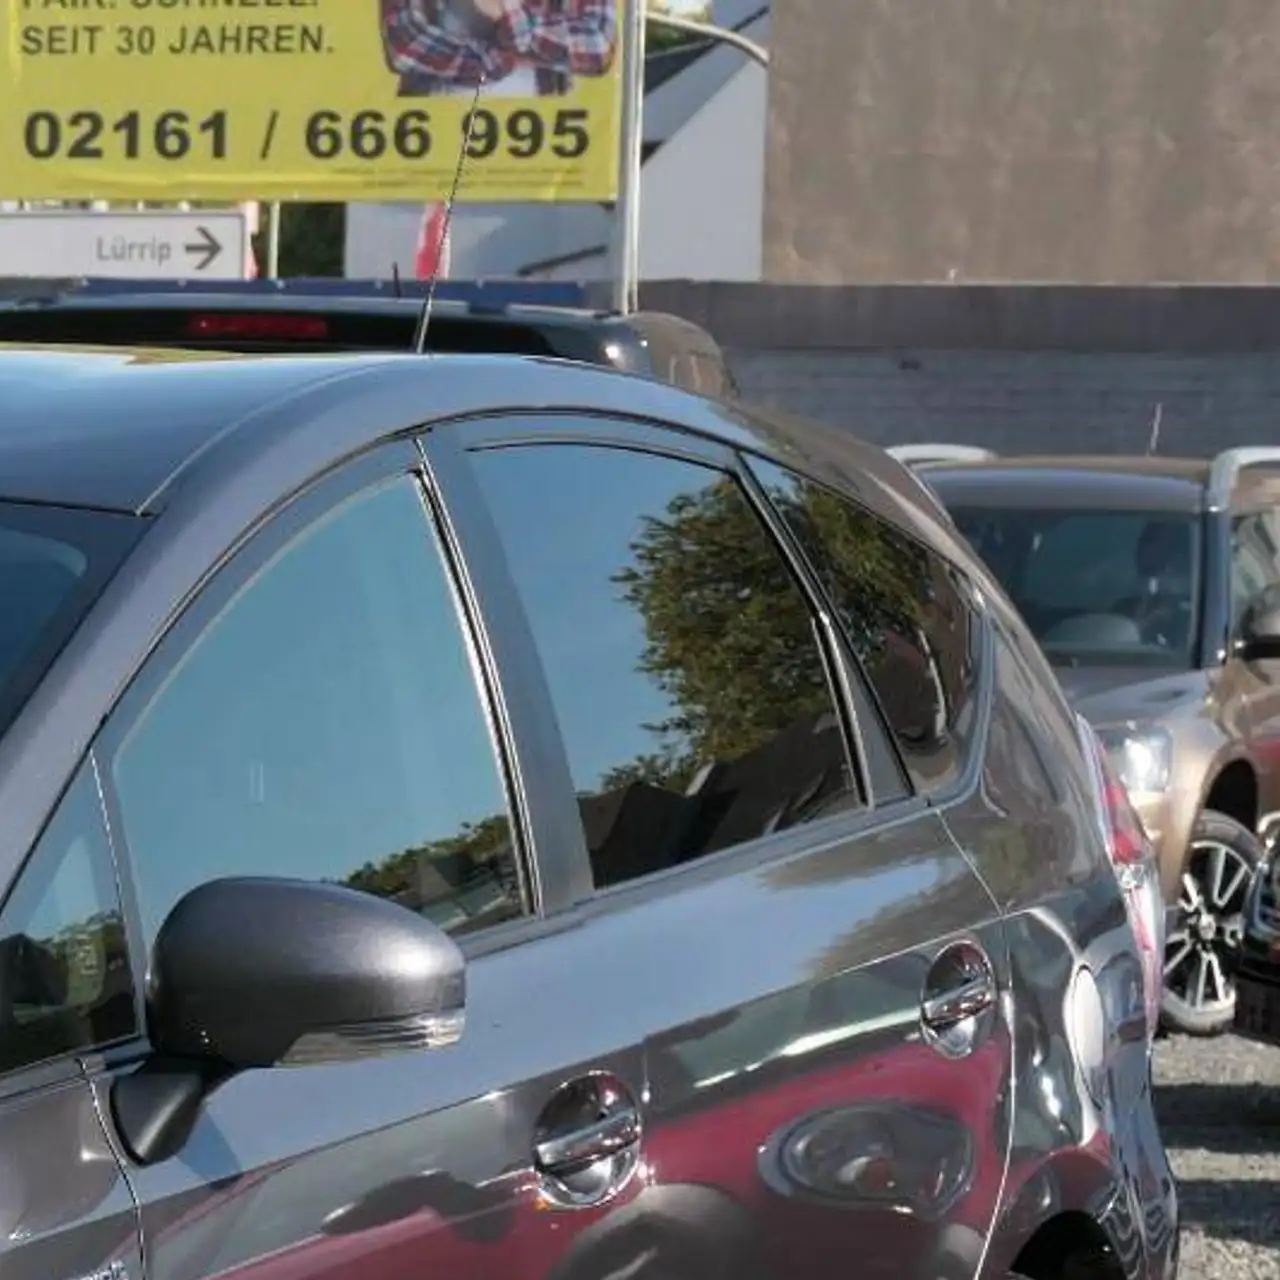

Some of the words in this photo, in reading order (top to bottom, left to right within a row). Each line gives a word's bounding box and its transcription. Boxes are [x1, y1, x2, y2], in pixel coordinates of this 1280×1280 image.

[21, 25, 102, 55] SEIT
[116, 25, 156, 55] 30
[168, 24, 334, 55] JAHREN.
[24, 109, 228, 160] 02161
[260, 110, 278, 160] /
[304, 109, 432, 160] 666
[460, 108, 590, 160] 995
[96, 235, 172, 266] Lürrip
